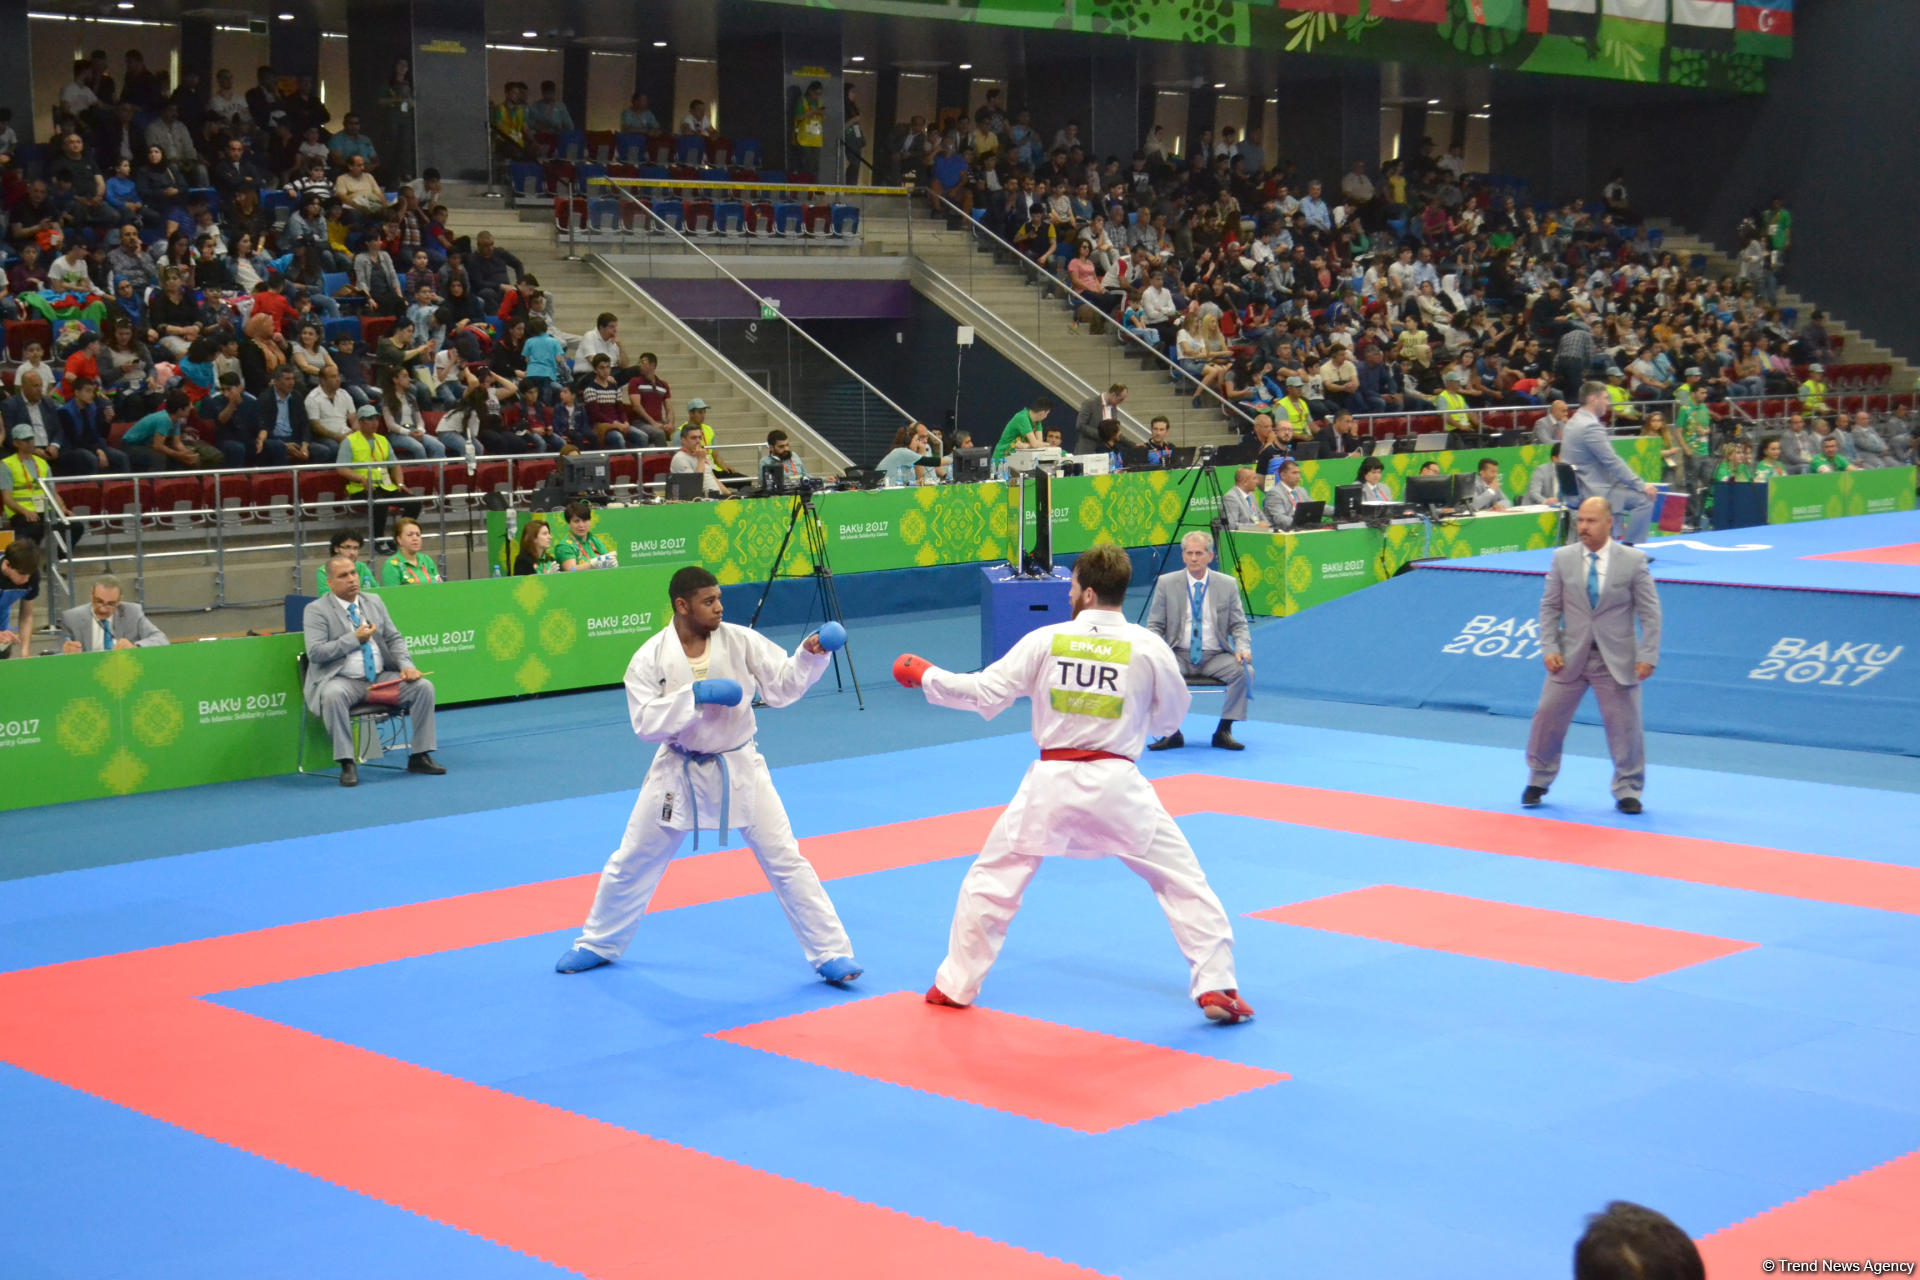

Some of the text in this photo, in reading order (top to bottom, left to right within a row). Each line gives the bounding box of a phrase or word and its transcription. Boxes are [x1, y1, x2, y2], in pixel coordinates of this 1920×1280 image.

[839, 521, 888, 534] BAKU 2017
[631, 537, 686, 552] BAKU 2017
[1343, 559, 1365, 571] 2017
[587, 612, 652, 630] BAKU 2017
[1460, 614, 1541, 639] BAK
[404, 629, 475, 648] BAKU 2017
[1069, 641, 1113, 656] ERKAN
[1767, 637, 1904, 666] BAKU
[1057, 661, 1119, 692] TUR
[1747, 658, 1885, 687] 2017
[198, 692, 287, 715] BAKU 2017
